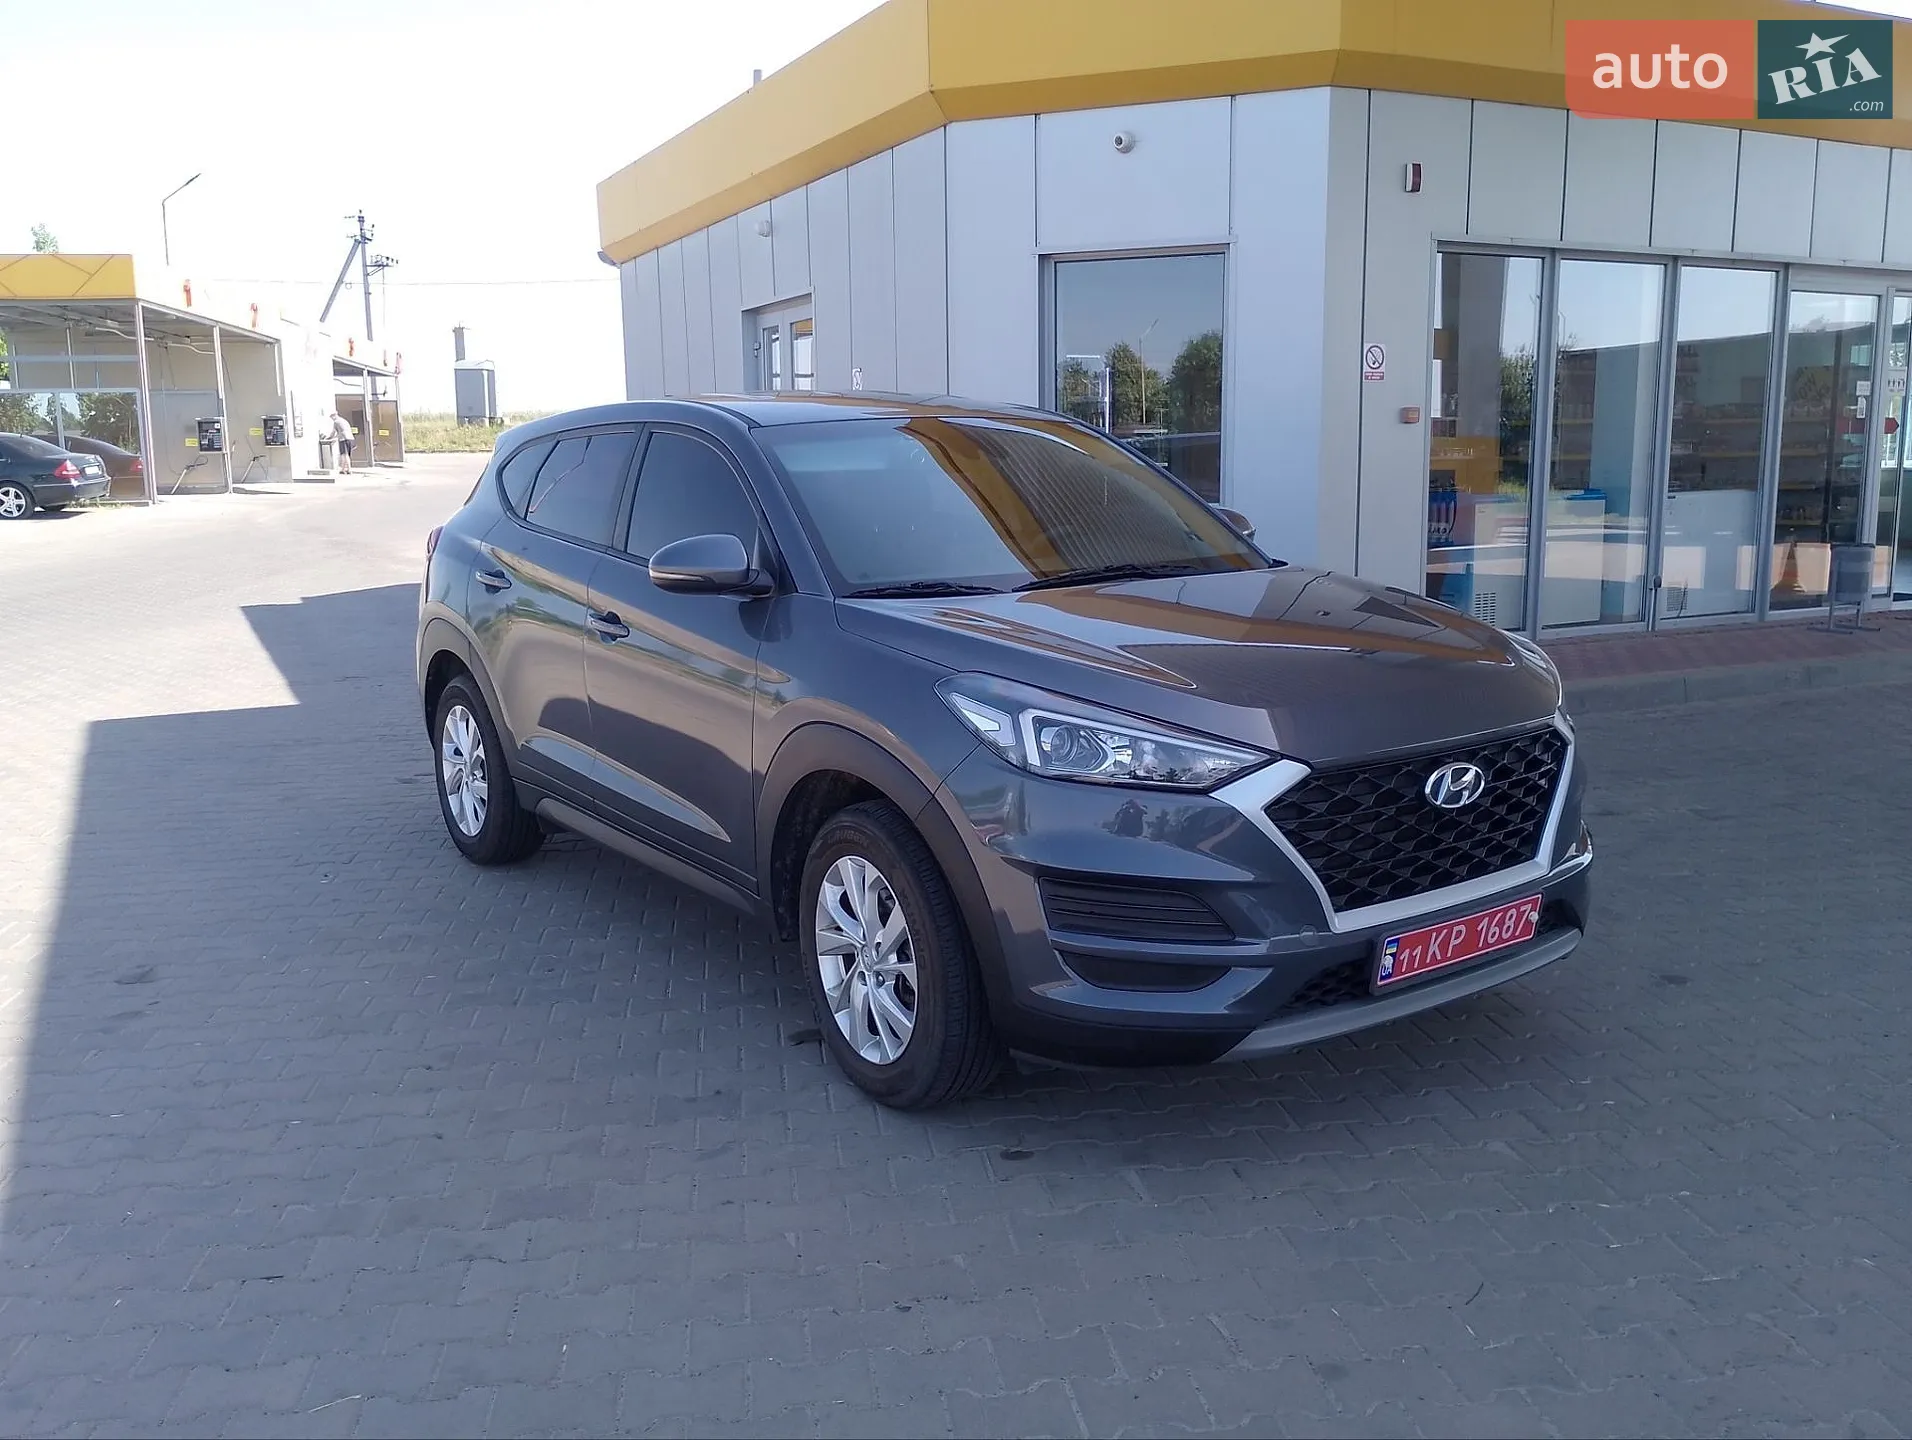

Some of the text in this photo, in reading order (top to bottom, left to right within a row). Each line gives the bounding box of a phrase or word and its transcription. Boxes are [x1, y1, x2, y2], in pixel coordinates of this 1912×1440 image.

[1400, 903, 1532, 973] 11 KP 1687
